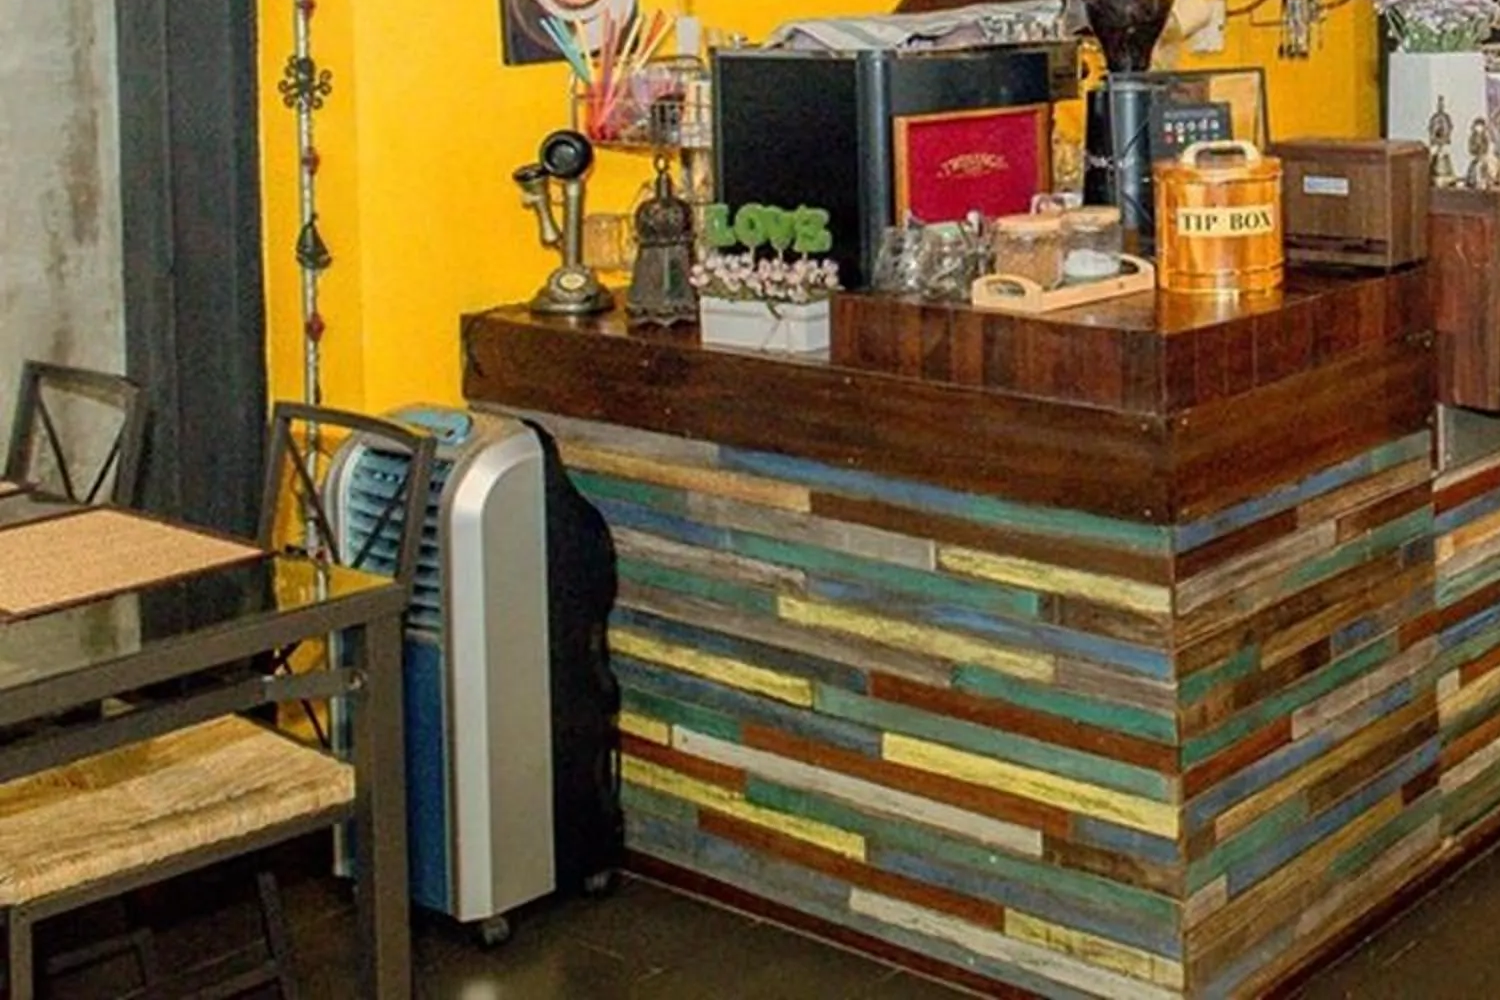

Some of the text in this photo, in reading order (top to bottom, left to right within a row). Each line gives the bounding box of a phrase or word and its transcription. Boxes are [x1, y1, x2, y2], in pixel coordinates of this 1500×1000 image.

[704, 202, 832, 253] LOVE
[1182, 210, 1272, 232] TIP BOX
